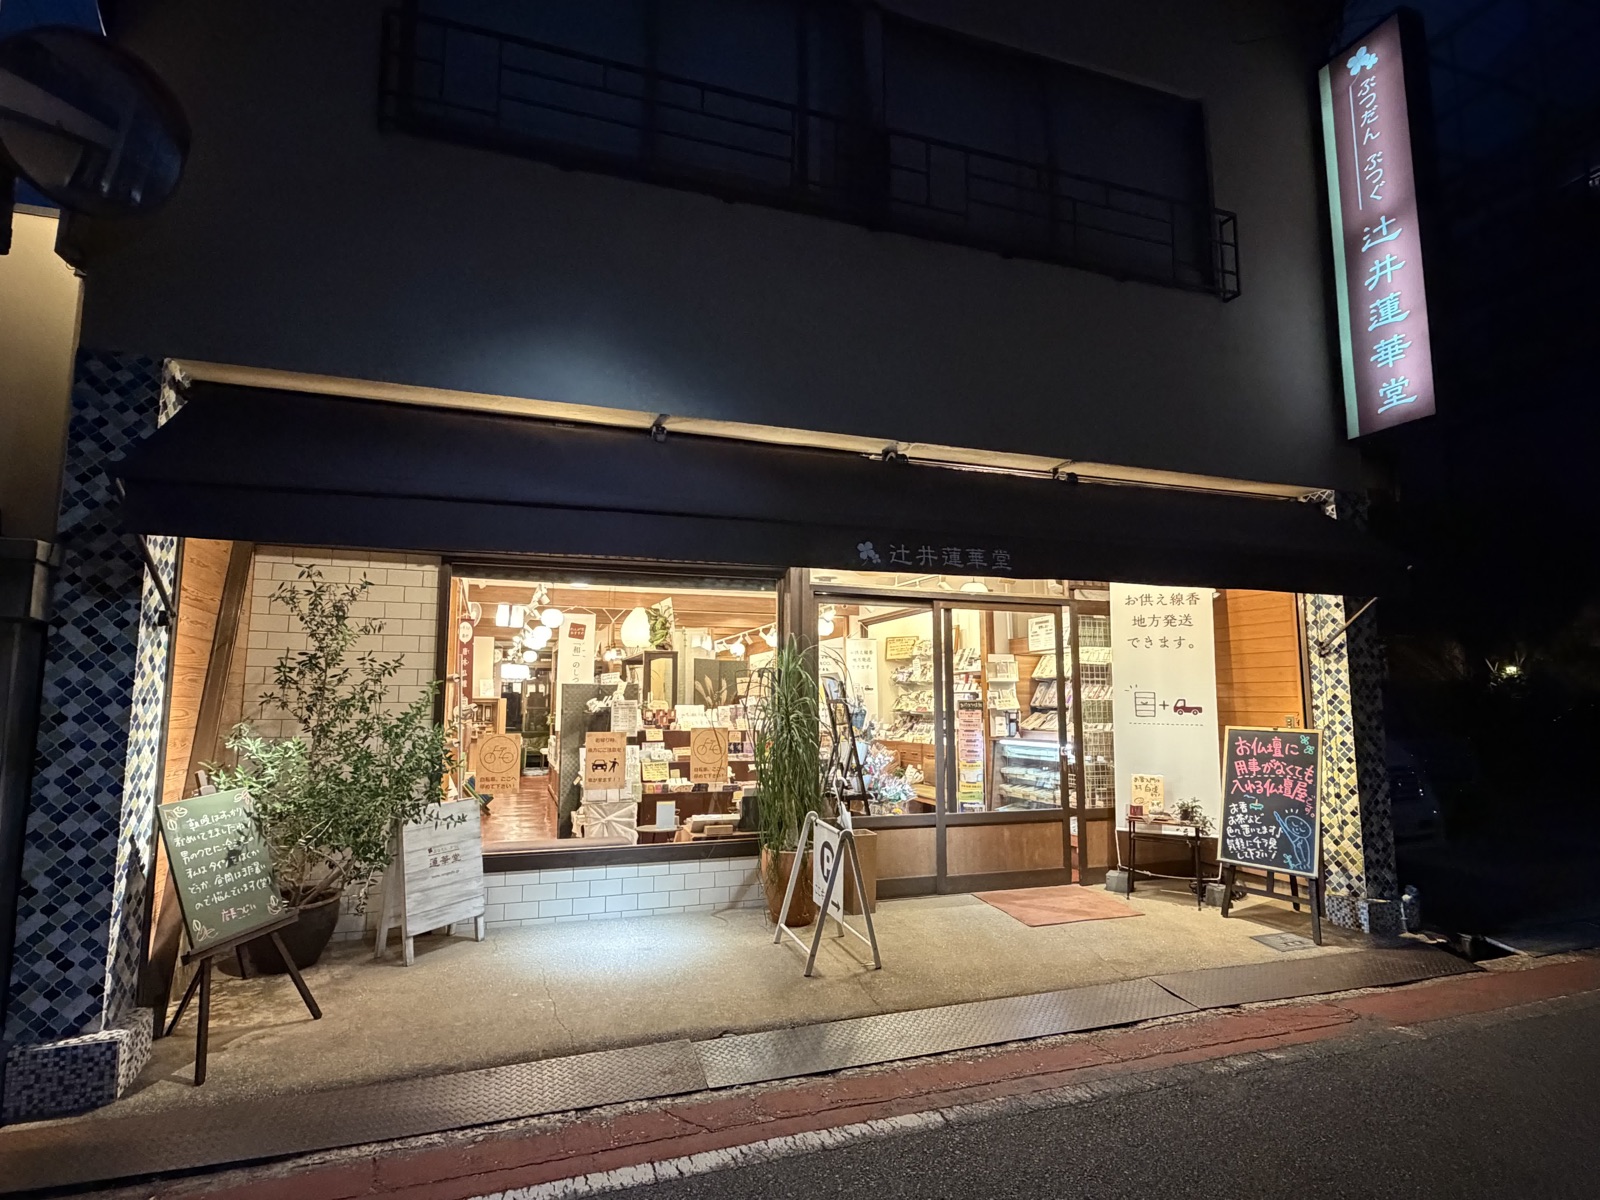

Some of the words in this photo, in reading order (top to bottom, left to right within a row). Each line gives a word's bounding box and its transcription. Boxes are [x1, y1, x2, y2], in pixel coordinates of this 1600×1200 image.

[1357, 74, 1380, 145] ぶつだん
[1363, 150, 1384, 202] ぶつぐ
[1361, 214, 1418, 416] 辻井蓮華堂
[889, 543, 1013, 572] 辻井蓮華堂
[1125, 592, 1200, 607] お供え線香
[1132, 614, 1194, 628] 地方発送
[1127, 635, 1194, 650] できます。
[1234, 736, 1300, 758] お仏壇に
[1234, 758, 1315, 784] 用事がなくても
[186, 807, 242, 832] 朝晩はすっかり
[1228, 812, 1265, 825] お茶など
[429, 852, 462, 869] 蓮華堂
